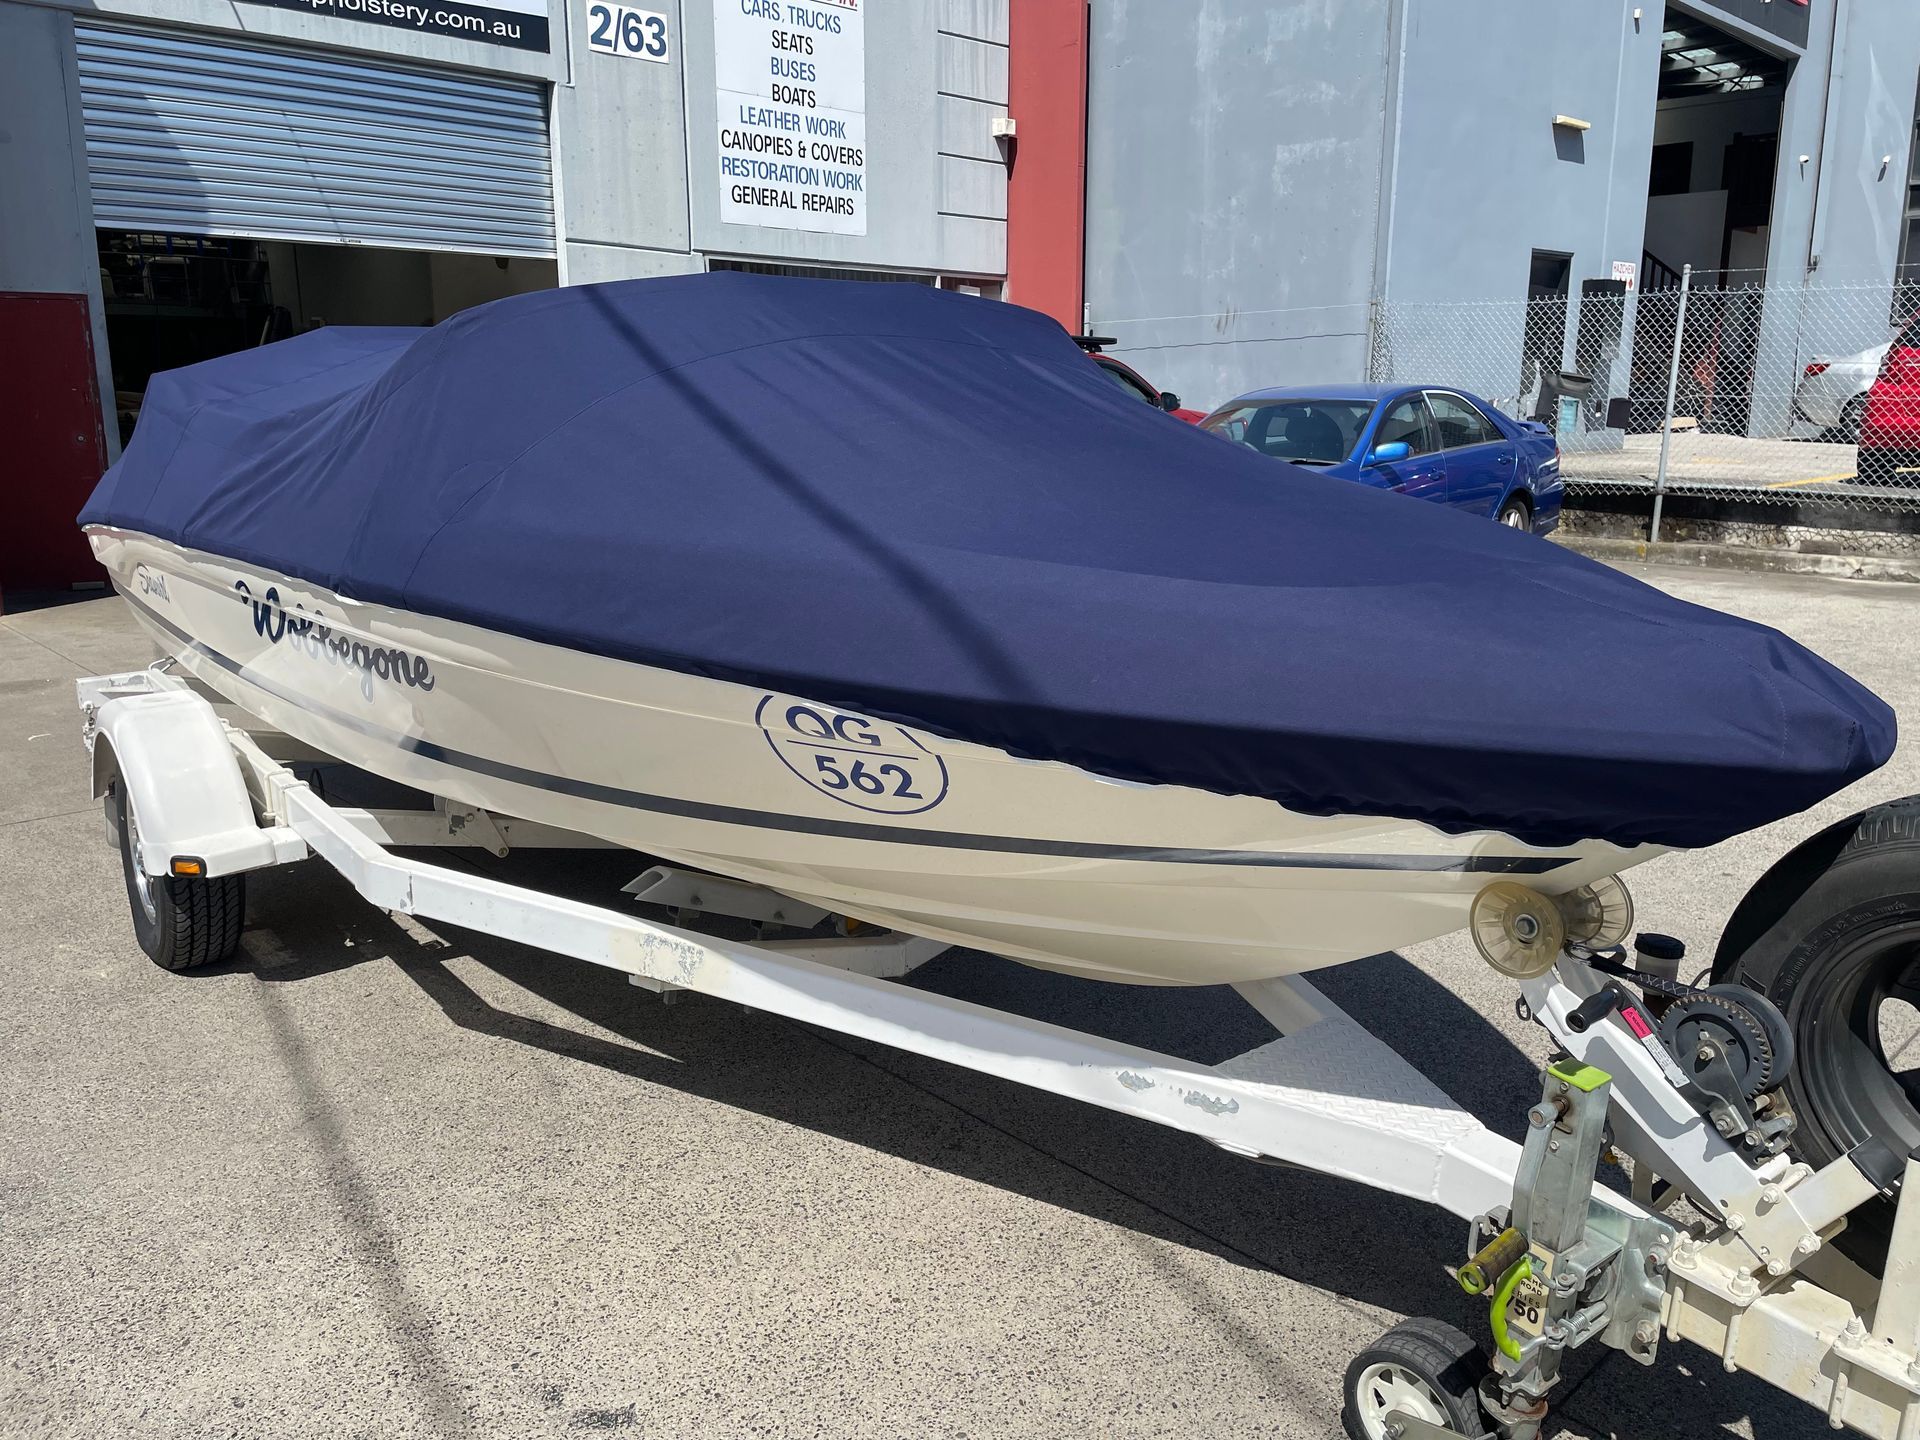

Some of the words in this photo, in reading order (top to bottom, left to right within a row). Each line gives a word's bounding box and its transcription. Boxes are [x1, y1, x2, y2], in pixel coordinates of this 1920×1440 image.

[302, 0, 521, 39] olstery.com.au
[590, 5, 667, 57] 2/63
[741, 0, 785, 23] CARS,
[787, 5, 842, 34] TRUCKS
[771, 29, 814, 56] SEATS
[771, 57, 816, 82] BUSES
[772, 83, 816, 109] BOATS
[740, 104, 801, 132] LEATHER
[805, 115, 847, 140] WORK
[721, 129, 793, 157] CANOPIES
[798, 140, 807, 158] &
[811, 142, 863, 167] COVERS
[721, 156, 819, 187] RESTORATION
[823, 169, 863, 192] WORK
[731, 184, 797, 210] GENERAL
[802, 192, 854, 216] REPAIRS
[785, 705, 882, 747] QG
[814, 754, 924, 800] 562
